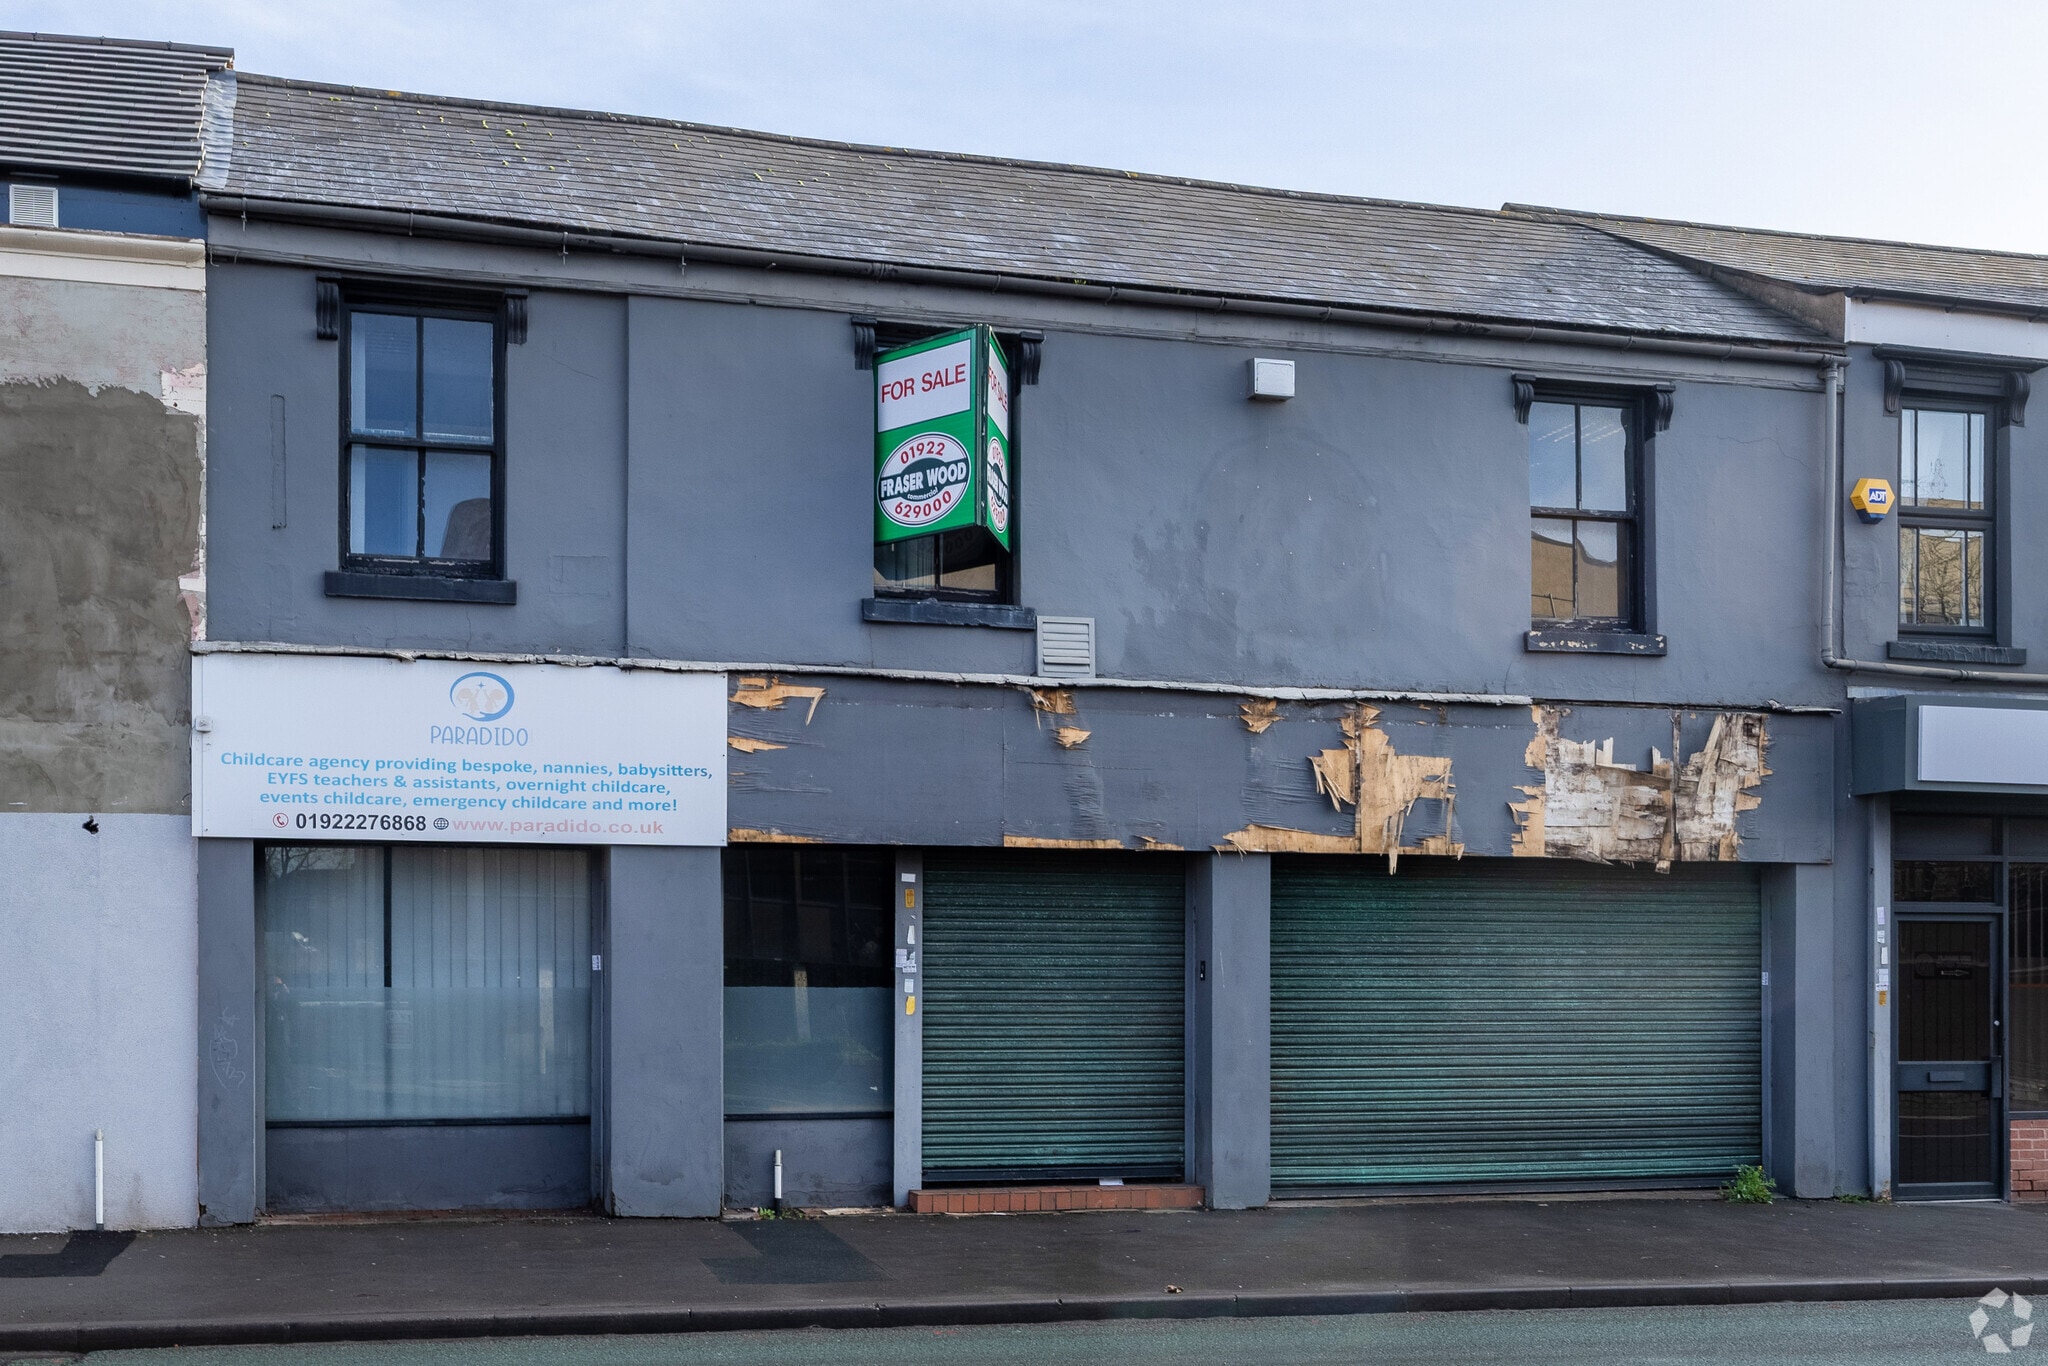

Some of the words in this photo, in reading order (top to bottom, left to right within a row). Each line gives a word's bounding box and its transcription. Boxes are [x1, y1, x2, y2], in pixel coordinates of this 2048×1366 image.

[881, 377, 915, 403] FOR
[921, 363, 966, 393] SALE
[900, 441, 946, 465] 01922
[880, 472, 924, 498] FRASER
[926, 461, 967, 486] WOOD
[895, 490, 952, 518] 629000
[907, 487, 939, 500] commercial
[1869, 490, 1886, 502] ADT
[430, 725, 529, 747] PARADIDO
[220, 752, 303, 767] Childcare
[309, 757, 370, 771] agency
[375, 758, 457, 774] providing
[462, 759, 538, 776] bespoke,
[543, 762, 613, 777] nannies,
[618, 763, 713, 779] babysitters,
[267, 772, 308, 785] EYFS
[313, 774, 388, 788] teachers
[393, 775, 407, 788] &
[413, 777, 501, 791] assistants,
[506, 779, 587, 795] overnight
[591, 780, 671, 796] childcare,
[259, 792, 318, 804] events
[323, 791, 407, 808] childcare,
[413, 795, 507, 811] emergency
[512, 796, 587, 810] childcare
[592, 798, 623, 811] and
[628, 799, 677, 811] more!
[295, 813, 427, 831] 01922276868
[453, 818, 664, 835] www.paradido.co.uk
